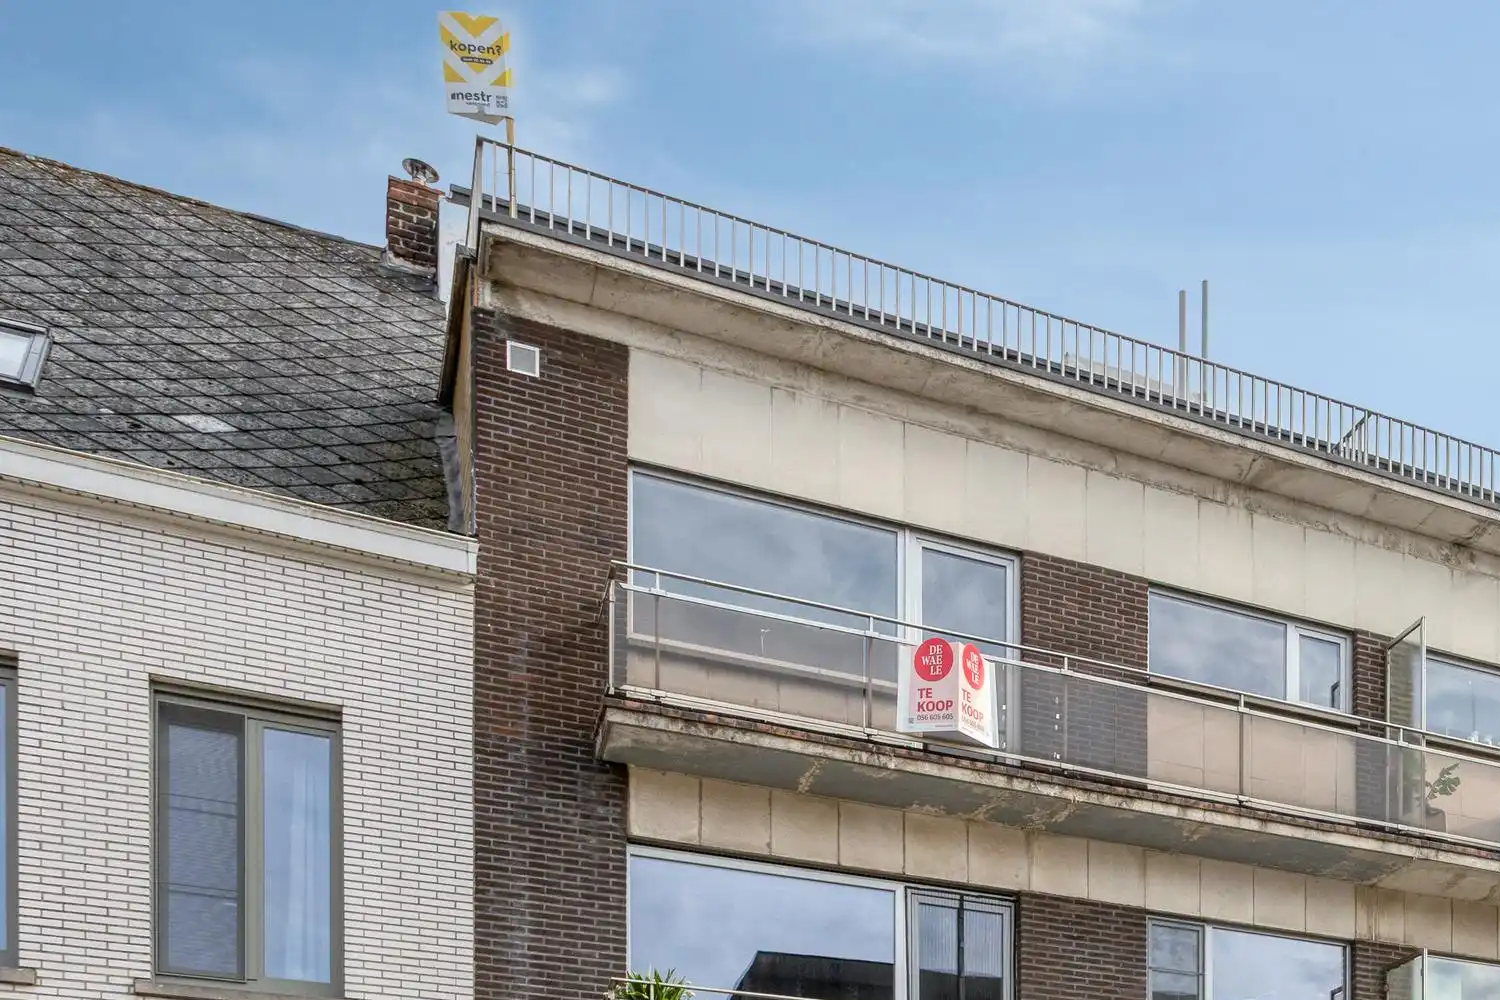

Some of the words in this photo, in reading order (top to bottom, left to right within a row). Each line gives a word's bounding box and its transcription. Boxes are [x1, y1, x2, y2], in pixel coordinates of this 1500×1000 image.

[449, 40, 502, 56] kopen?
[929, 644, 943, 655] DE
[921, 655, 943, 665] WAE
[930, 665, 943, 675] LE
[917, 688, 932, 698] TE
[961, 688, 972, 703] TE
[917, 700, 953, 712] KOOP
[961, 702, 984, 722] KOOP
